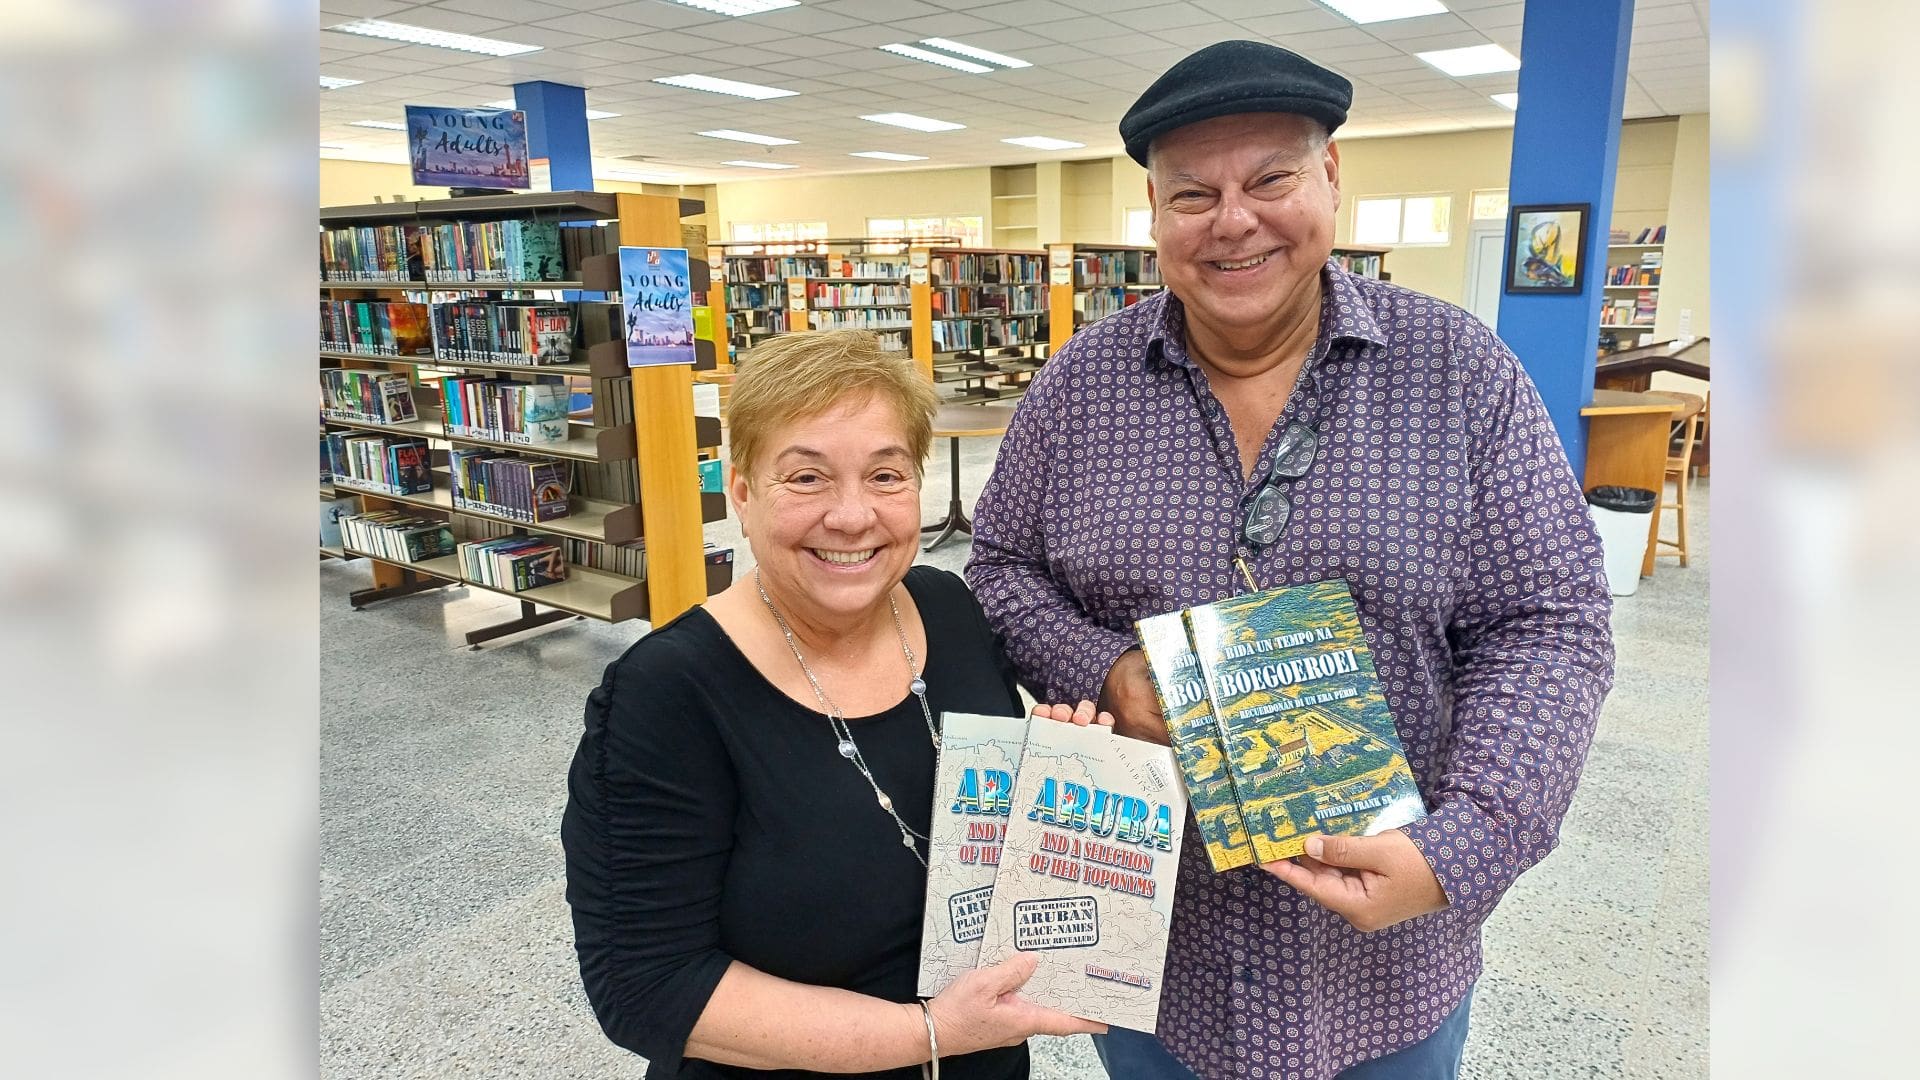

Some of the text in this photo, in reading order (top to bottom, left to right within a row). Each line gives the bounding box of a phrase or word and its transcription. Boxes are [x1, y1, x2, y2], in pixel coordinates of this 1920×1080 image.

[429, 113, 504, 130] YOUNG
[435, 131, 503, 156] Adults
[628, 274, 684, 288] YOUNG
[632, 291, 684, 312] Adults
[1225, 627, 1334, 660] BIDA UN TEMPO NA
[1220, 649, 1359, 698] BOEGOEROEI
[1295, 698, 1305, 708] DI
[1305, 696, 1318, 706] UN
[1318, 692, 1333, 703] ERA
[1146, 762, 1165, 789] ENGLISH
[951, 767, 1013, 816] AR
[1027, 776, 1173, 852] ARUBA
[1315, 804, 1353, 820] VIVIENNO
[1353, 797, 1382, 812] FRANK
[968, 822, 996, 841] AND
[959, 844, 1002, 865] OF HE
[1040, 832, 1153, 873] AND A SELECTION
[1029, 853, 1156, 898] OF HER TOPONYMS
[952, 895, 973, 904] THE
[1041, 901, 1077, 910] ORIGIN
[1018, 908, 1094, 925] ARUBAN
[1019, 923, 1094, 937] PLACE-NAMES
[1019, 934, 1095, 947] FINALLY REVEALED!
